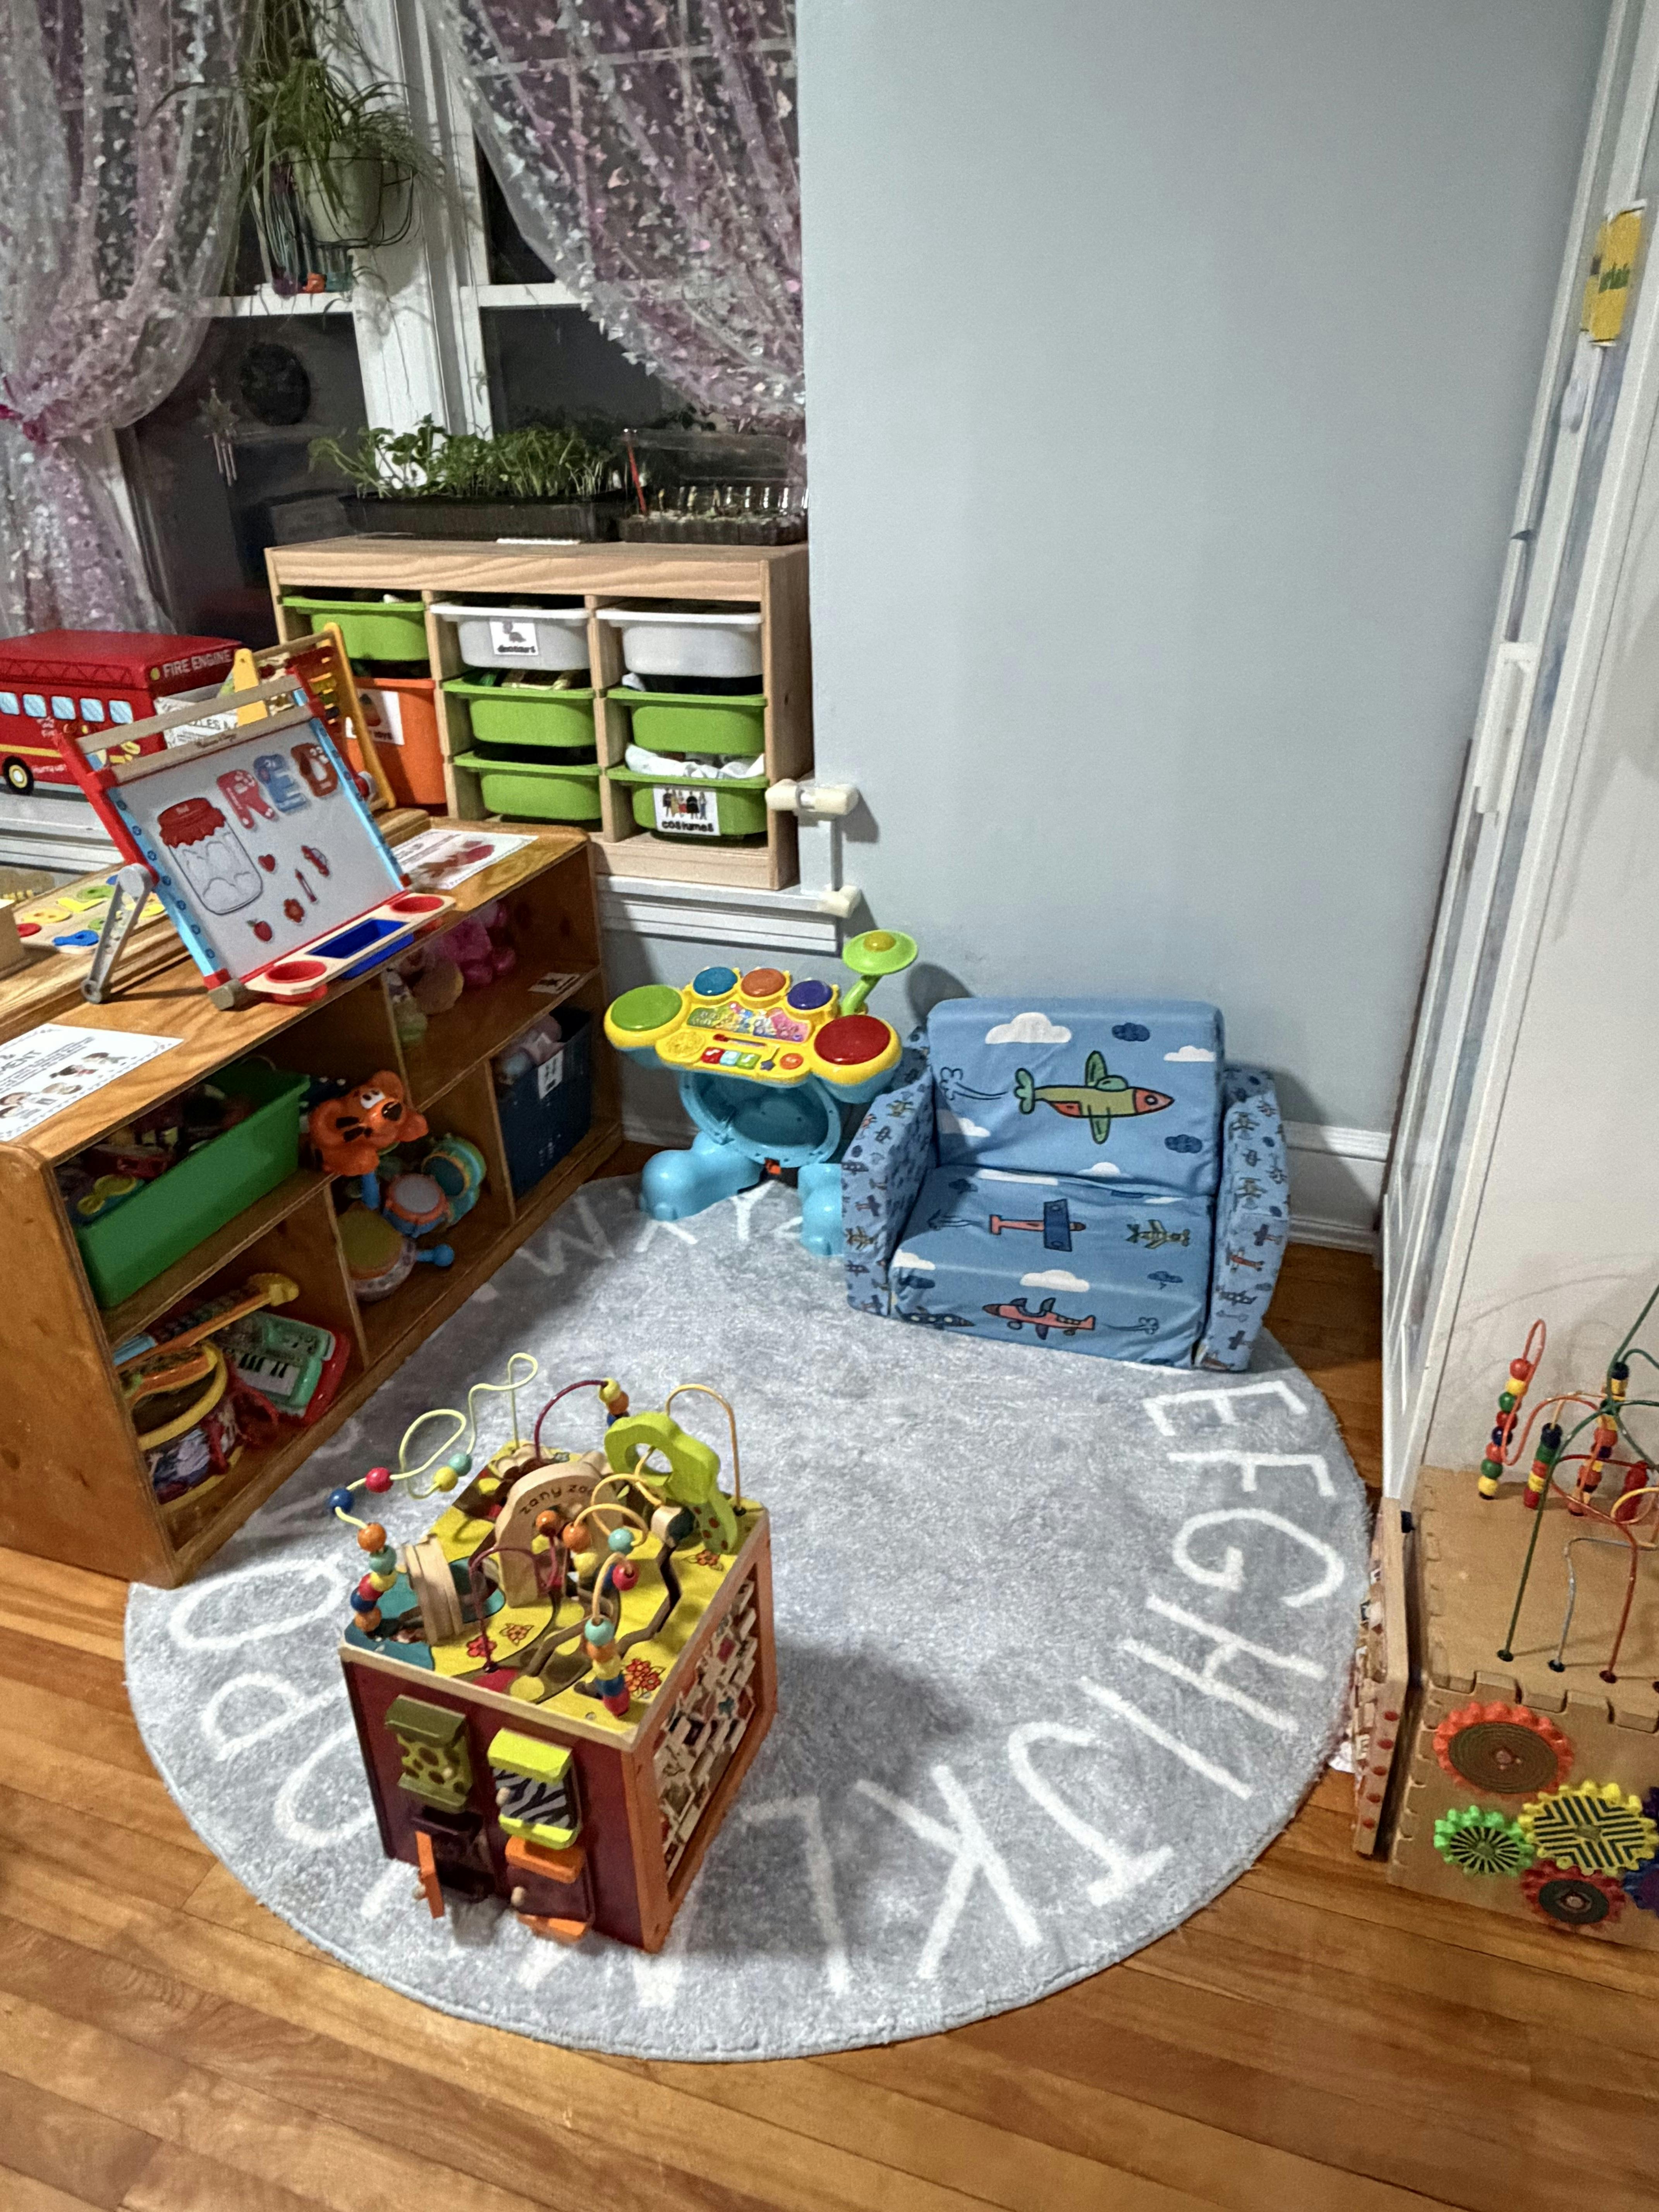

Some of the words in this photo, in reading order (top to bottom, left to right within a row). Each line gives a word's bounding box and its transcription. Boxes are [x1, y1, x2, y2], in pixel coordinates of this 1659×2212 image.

[163, 658, 191, 678] FIRE
[191, 649, 232, 670] ENGINE
[661, 820, 714, 832] costumes
[1143, 1379, 1308, 1437] E
[1167, 1449, 1336, 1497] F
[1172, 1508, 1345, 1608] G
[1120, 1593, 1327, 1734] H
[1007, 1721, 1173, 1907] J
[738, 1795, 850, 1997] L
[855, 1764, 1044, 1978] K
